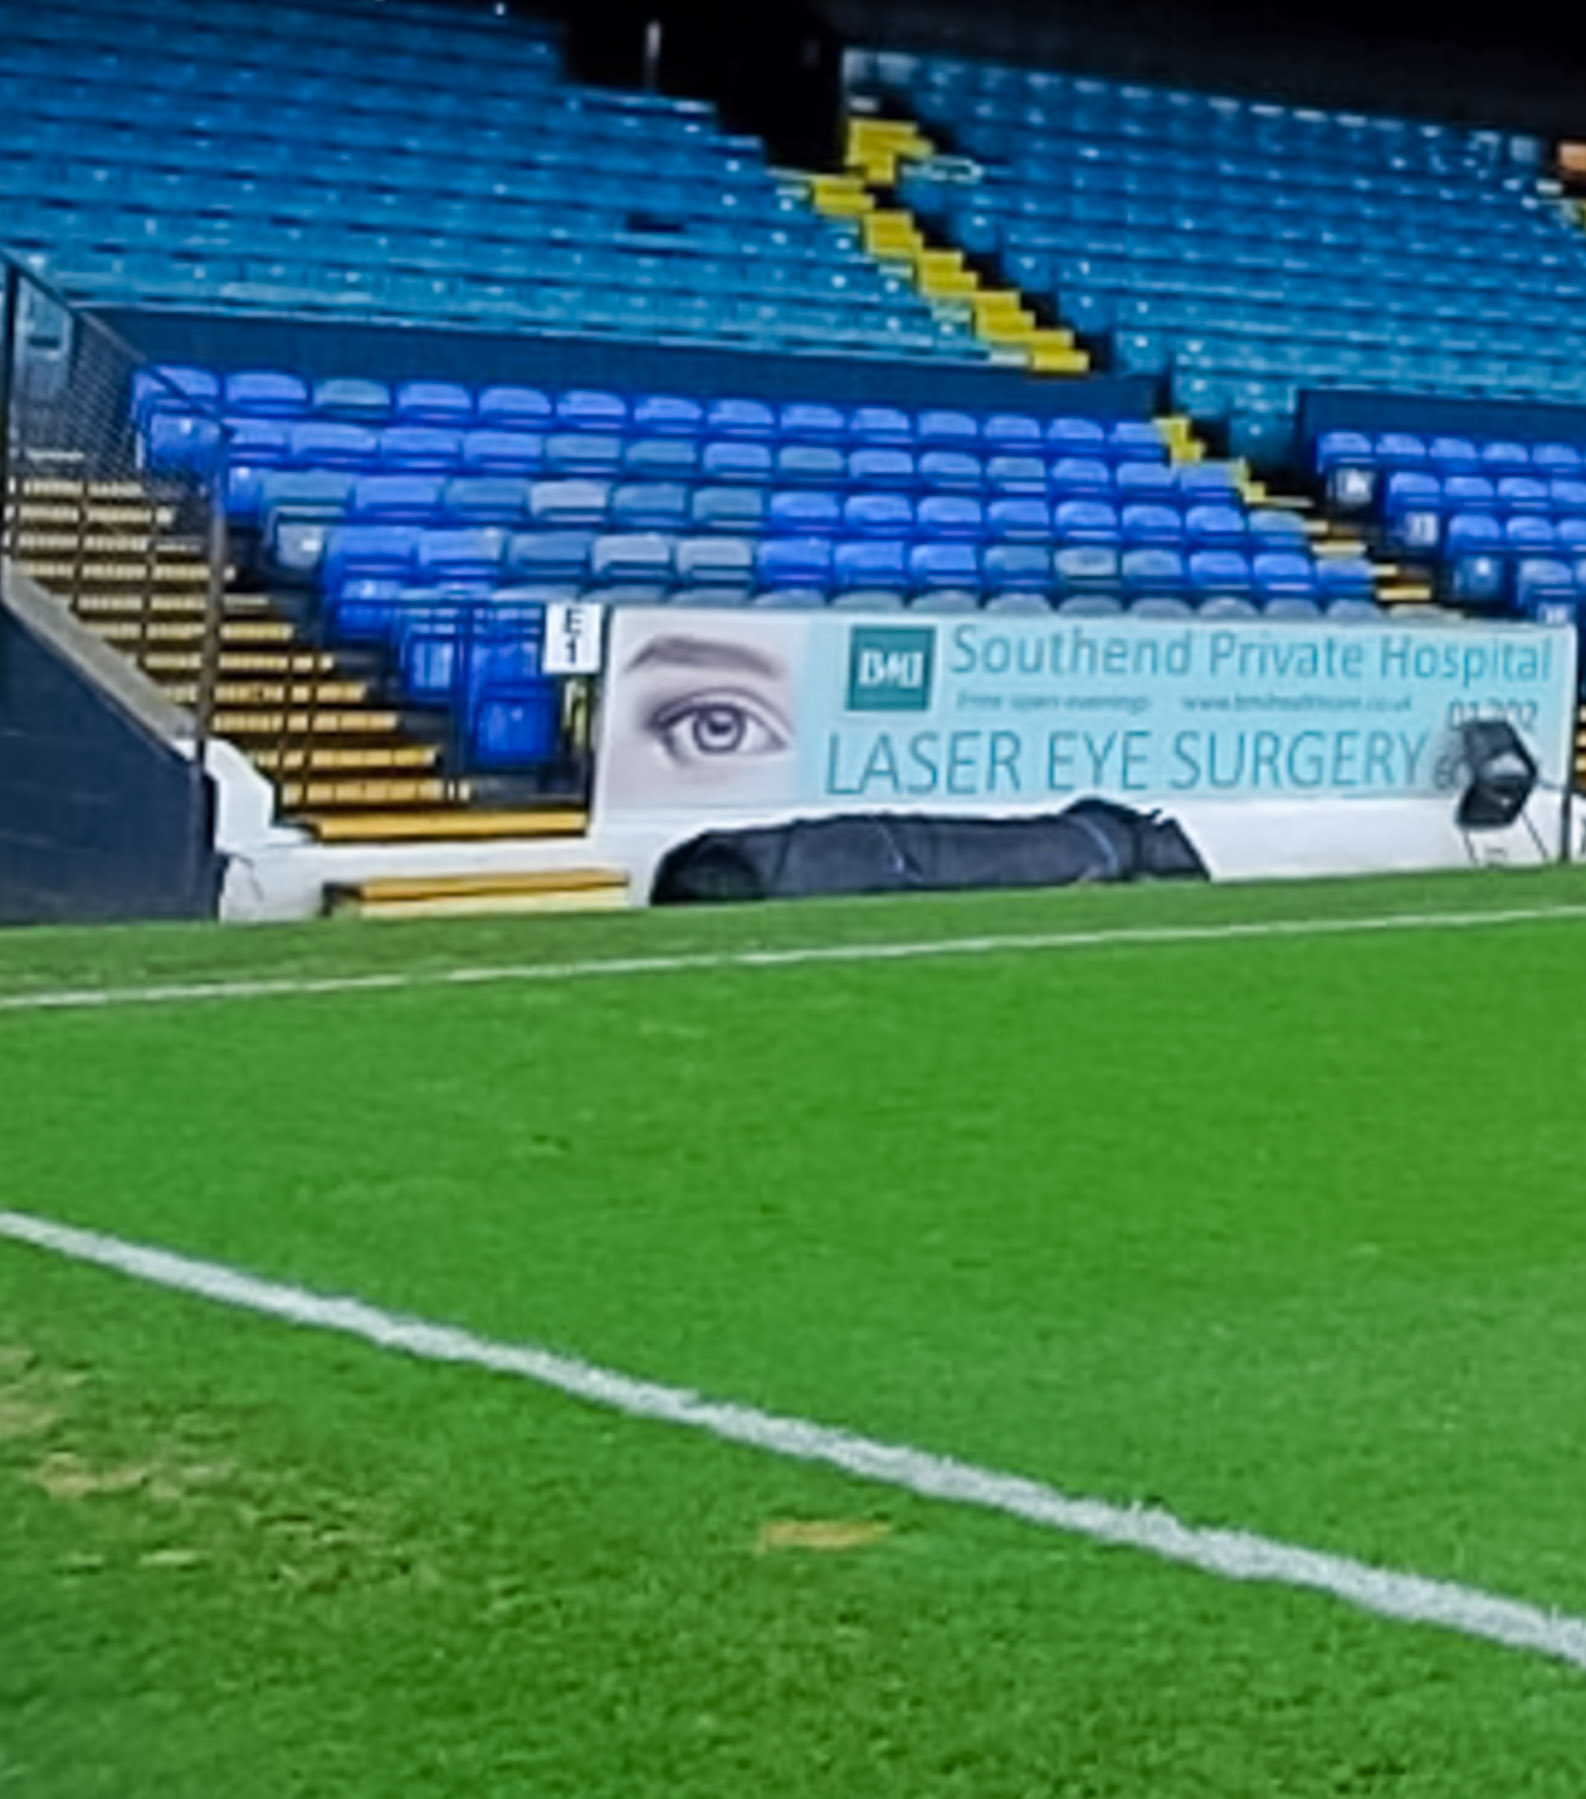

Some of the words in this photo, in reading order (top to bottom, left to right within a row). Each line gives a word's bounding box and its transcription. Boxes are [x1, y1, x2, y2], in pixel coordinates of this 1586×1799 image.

[951, 624, 1192, 677] Southend
[1209, 631, 1363, 680] Private
[1379, 634, 1553, 687] Hospital
[826, 732, 1021, 794] LASER
[1049, 730, 1153, 791] EYE
[1169, 730, 1427, 790] SURGERY
